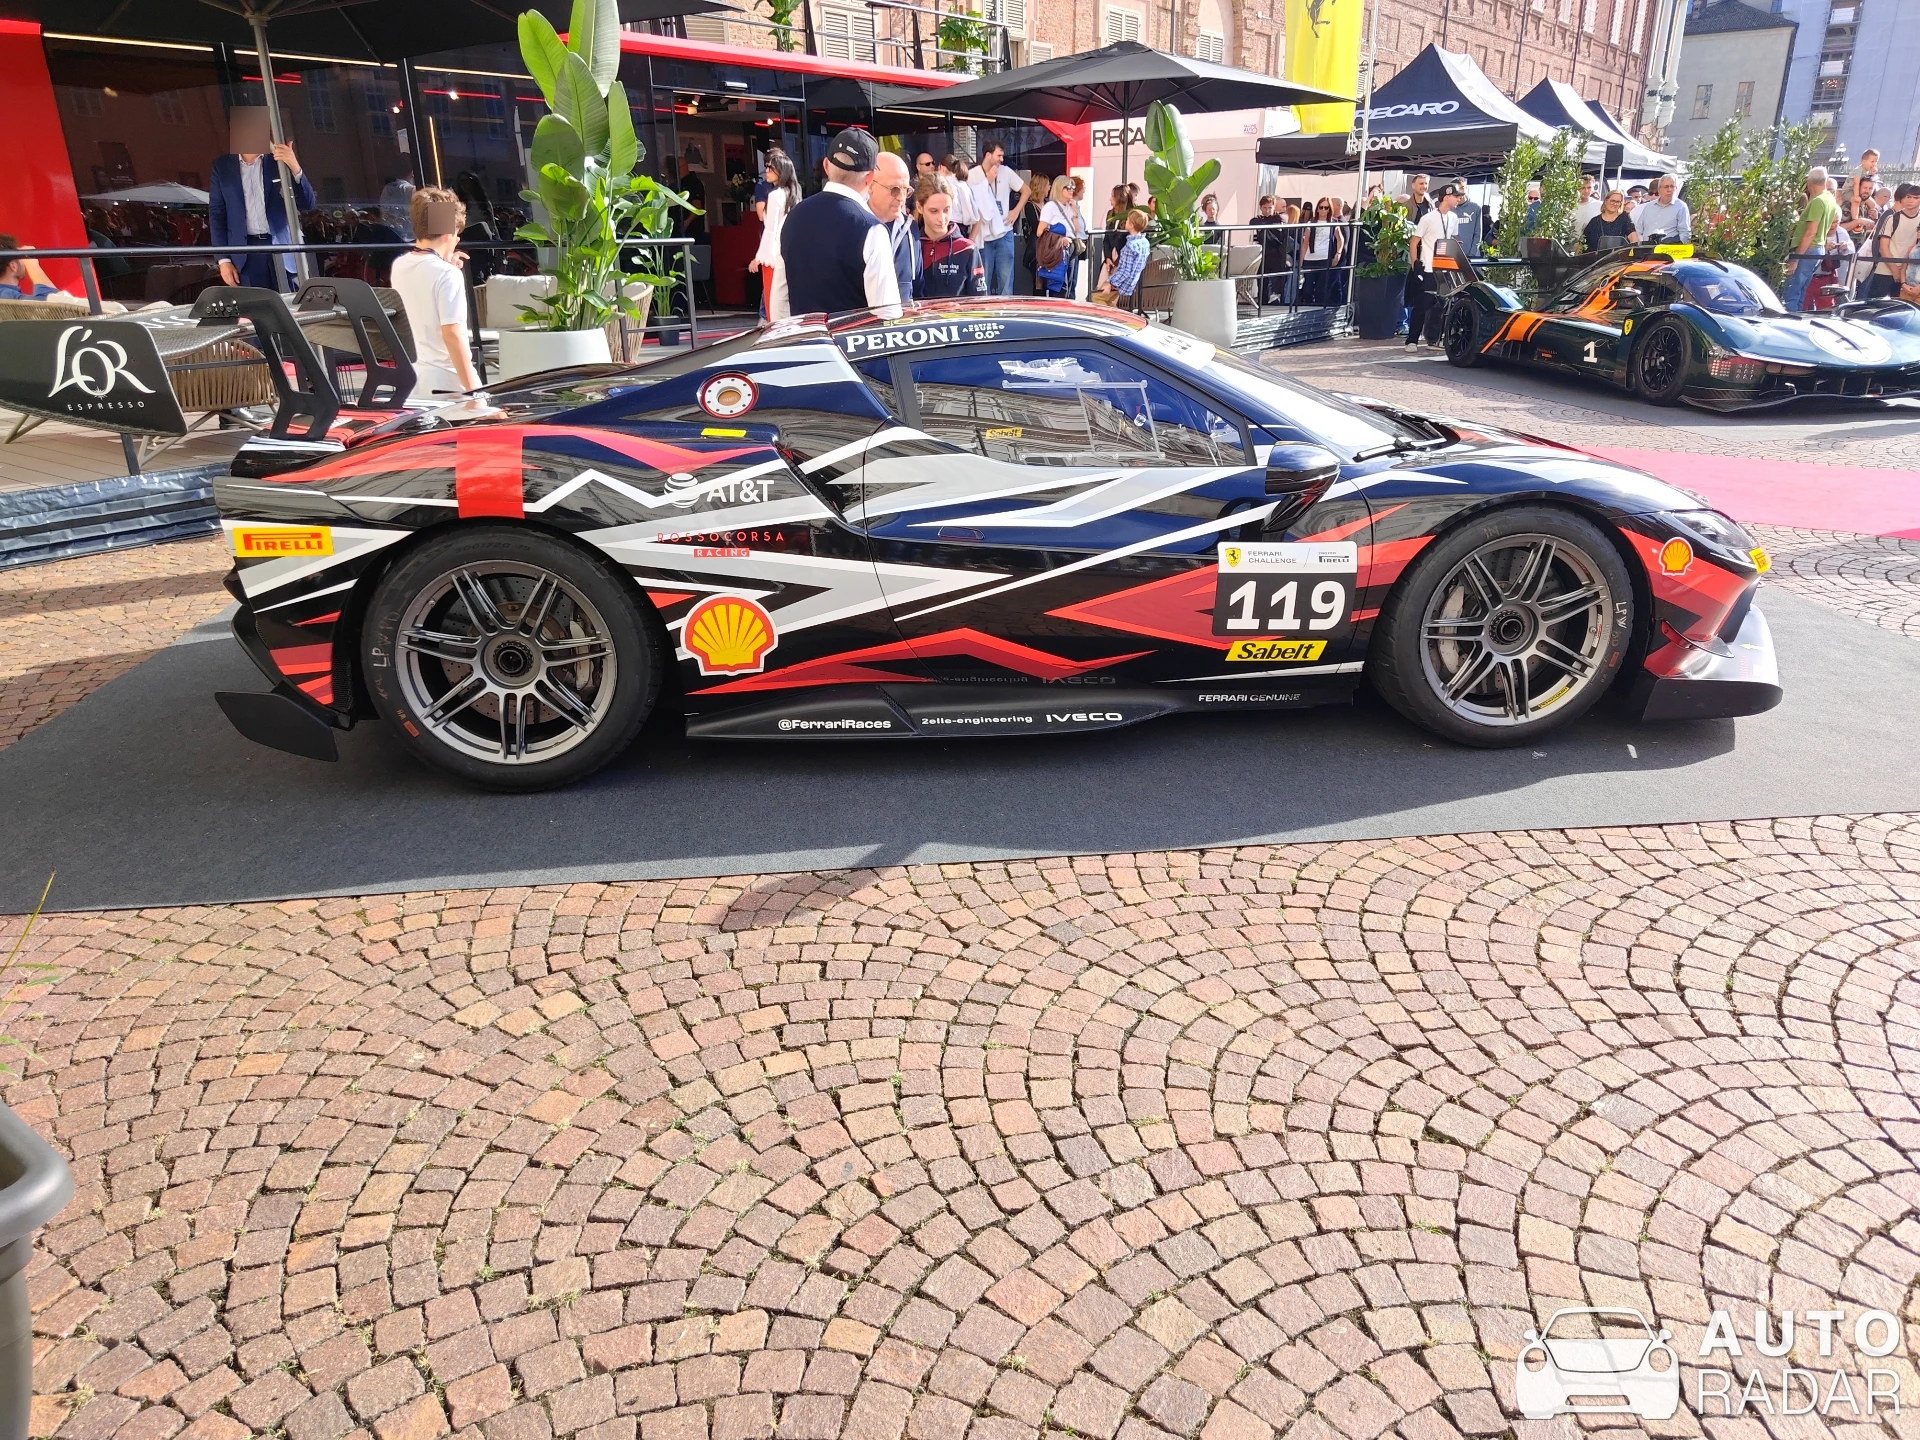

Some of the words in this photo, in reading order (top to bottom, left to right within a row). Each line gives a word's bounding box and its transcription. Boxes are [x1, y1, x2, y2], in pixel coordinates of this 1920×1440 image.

[1093, 127, 1146, 147] RECA
[845, 325, 961, 353] PERONI
[1583, 341, 1598, 363] 1
[67, 401, 146, 411] ESPRESSO
[706, 480, 775, 503] AT&T
[243, 533, 324, 551] PIRELLI
[657, 531, 784, 543] ROSSOCORSA
[696, 548, 748, 557] RACING
[1318, 555, 1350, 563] PIRELLI
[1226, 580, 1346, 631] 119
[1237, 642, 1315, 660] Sabelt
[1198, 694, 1248, 702] FERRARI
[1249, 693, 1301, 702] GENUINE
[778, 718, 892, 731] @FerrariRaces
[1045, 712, 1123, 723] IVECO
